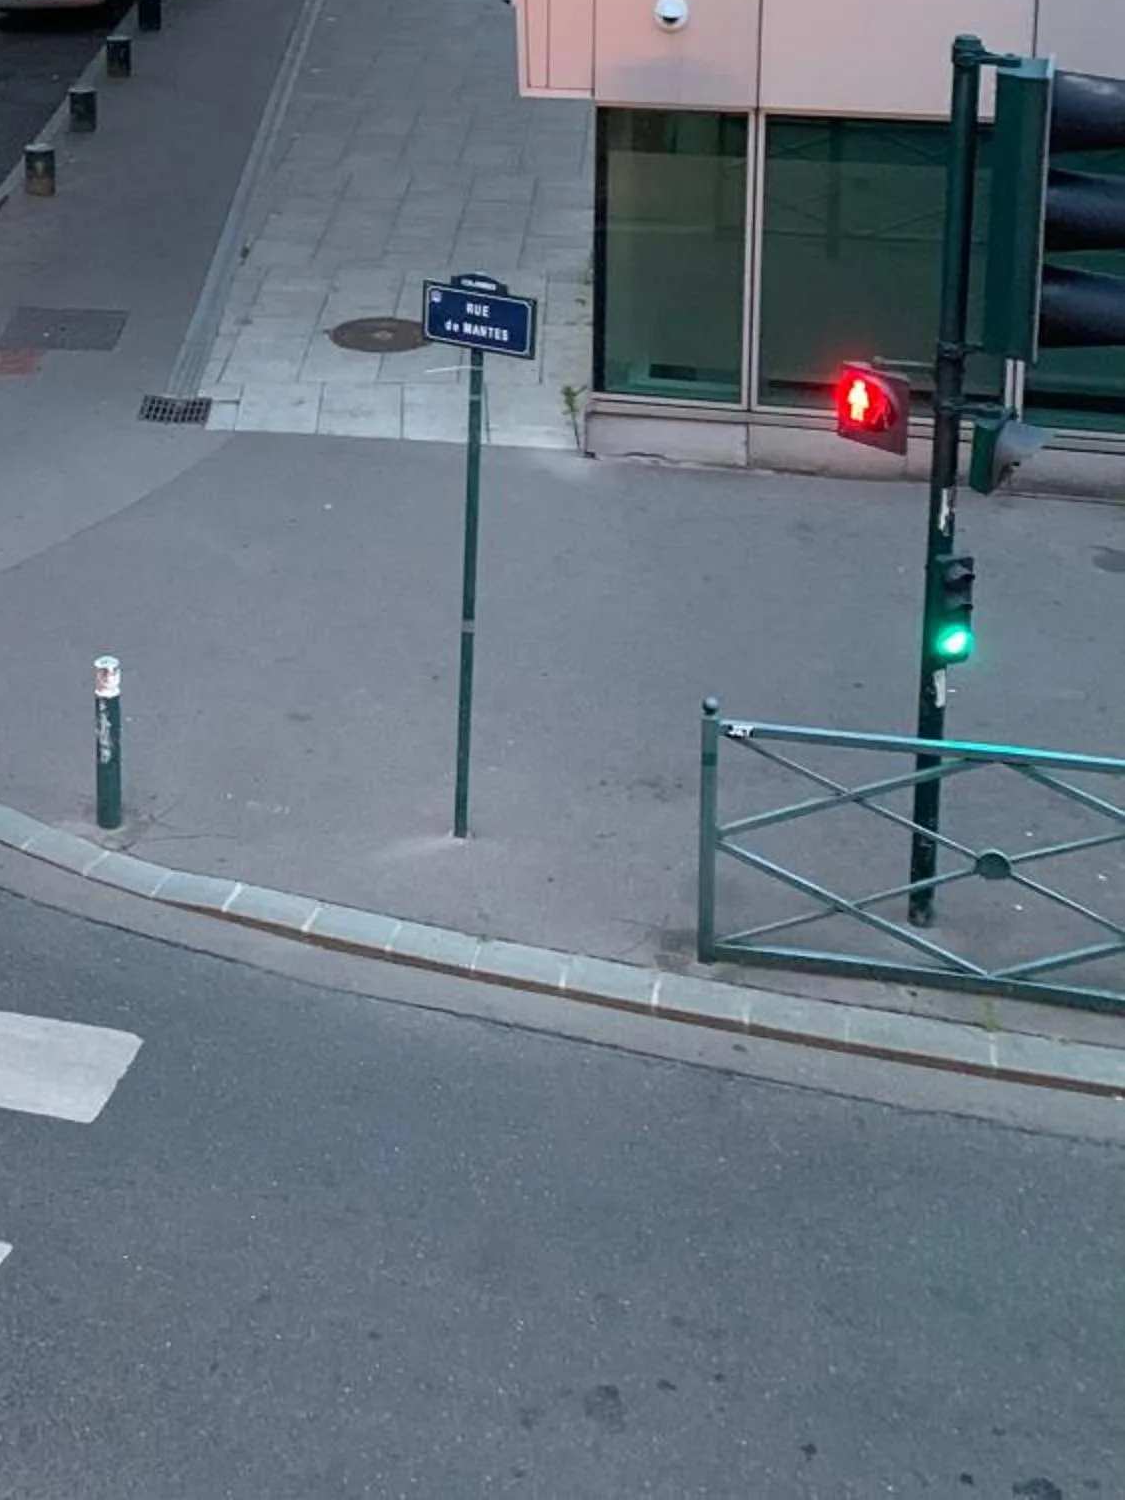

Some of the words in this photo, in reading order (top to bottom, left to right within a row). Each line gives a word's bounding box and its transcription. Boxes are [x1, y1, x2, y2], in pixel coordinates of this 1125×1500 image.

[466, 303, 490, 317] RUE
[445, 320, 460, 332] de
[463, 322, 509, 341] MANTES
